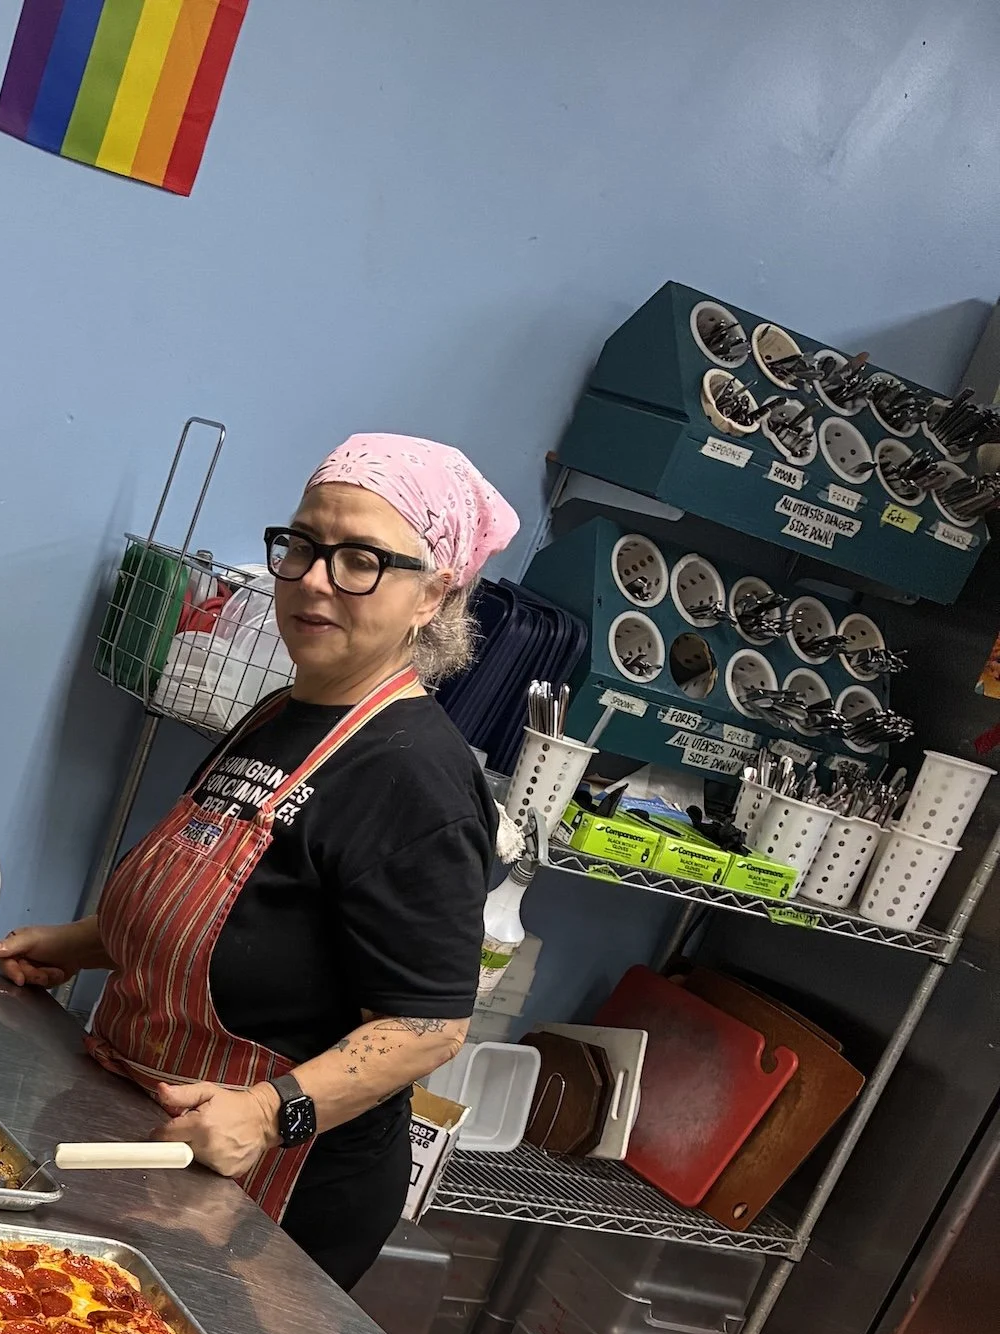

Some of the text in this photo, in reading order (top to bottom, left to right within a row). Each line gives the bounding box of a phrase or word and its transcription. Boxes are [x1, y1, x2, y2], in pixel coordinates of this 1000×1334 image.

[711, 442, 742, 461] SPOONS
[774, 466, 798, 485] SPOONS
[831, 491, 856, 506] FORKS
[780, 498, 793, 513] ALL
[825, 513, 855, 533] DANGER
[789, 519, 810, 538] SIDE
[610, 696, 636, 711] SPOONS
[670, 710, 699, 729] FORKS
[673, 733, 690, 746] ALL
[726, 730, 750, 744] FORKS
[688, 752, 710, 765] SIDE
[409, 1122, 434, 1139] 687
